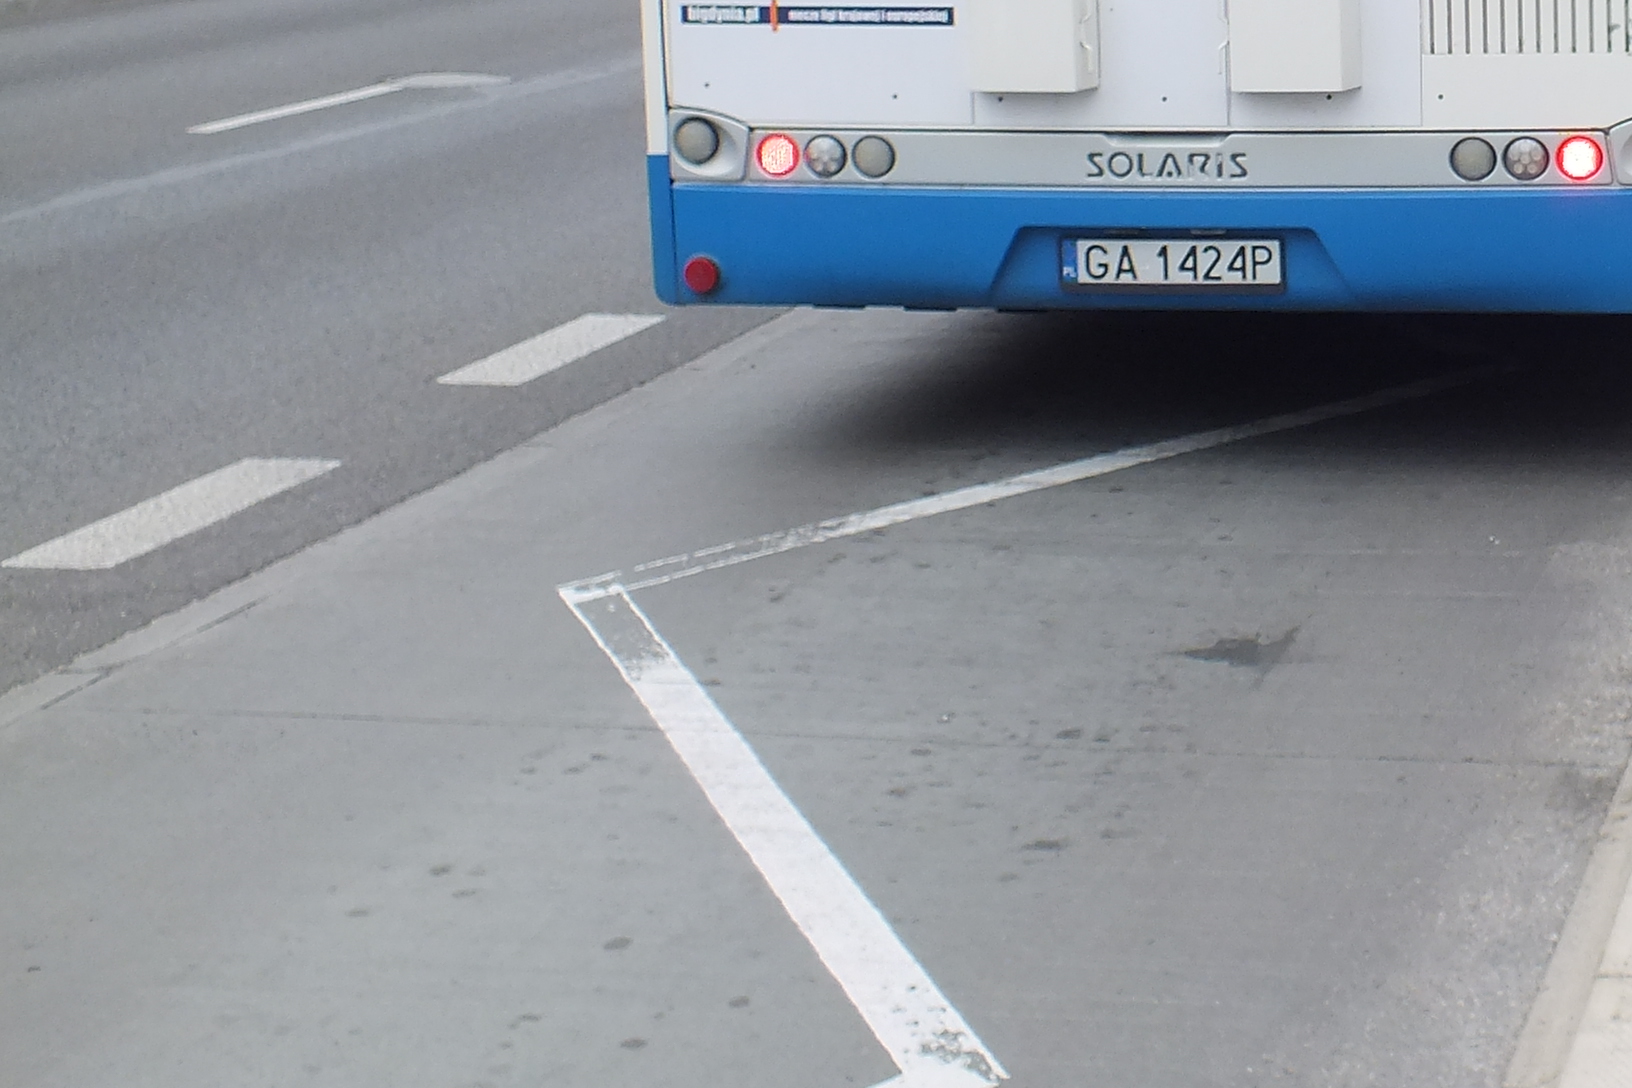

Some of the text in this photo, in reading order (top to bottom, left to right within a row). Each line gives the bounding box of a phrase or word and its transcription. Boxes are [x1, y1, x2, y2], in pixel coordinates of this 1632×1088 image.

[1086, 151, 1249, 178] SOLARIS
[1084, 244, 1273, 280] GA 1424P
